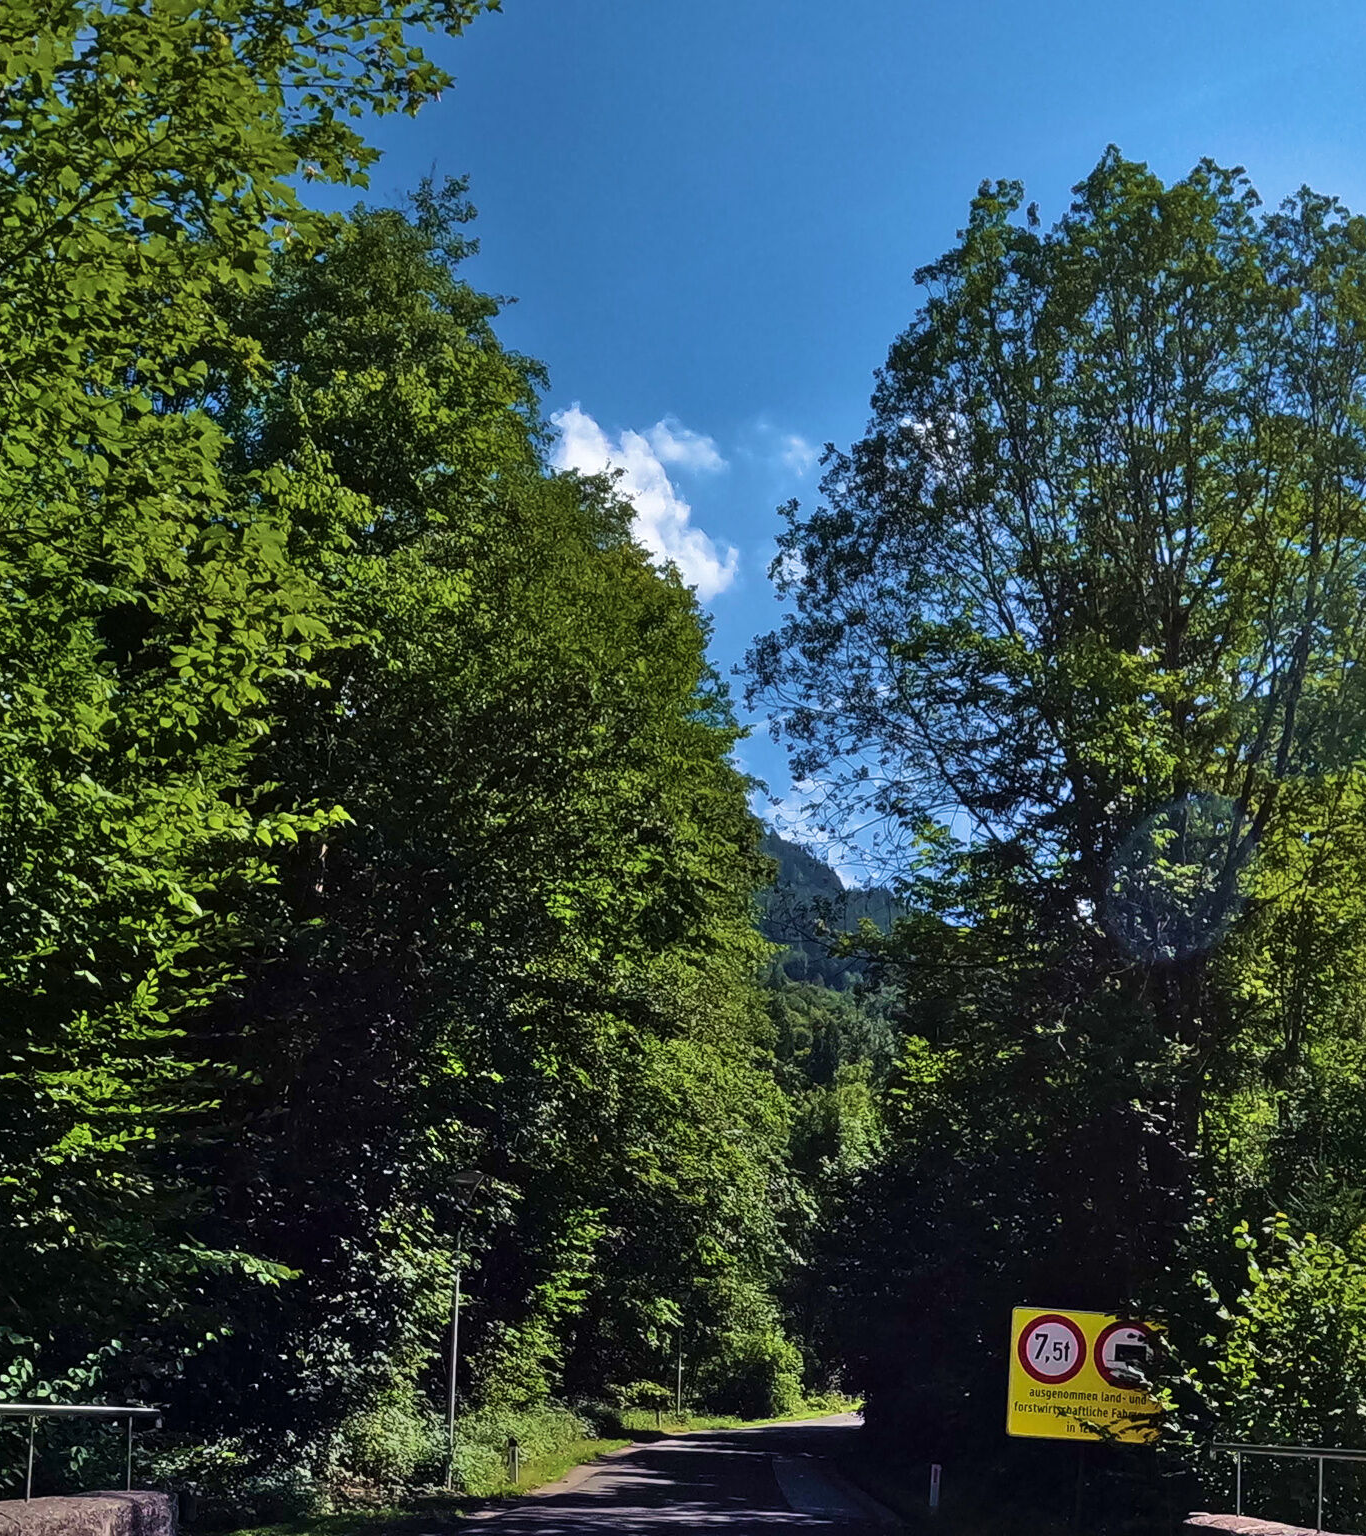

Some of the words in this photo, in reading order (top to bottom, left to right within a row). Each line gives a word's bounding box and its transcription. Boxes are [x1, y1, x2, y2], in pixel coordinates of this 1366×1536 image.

[1035, 1332, 1070, 1363] 7,5t
[1029, 1388, 1098, 1401] ausgenommen
[1101, 1391, 1126, 1404] land-
[1129, 1393, 1147, 1405] und
[1014, 1401, 1109, 1417] forstwirthaftliche
